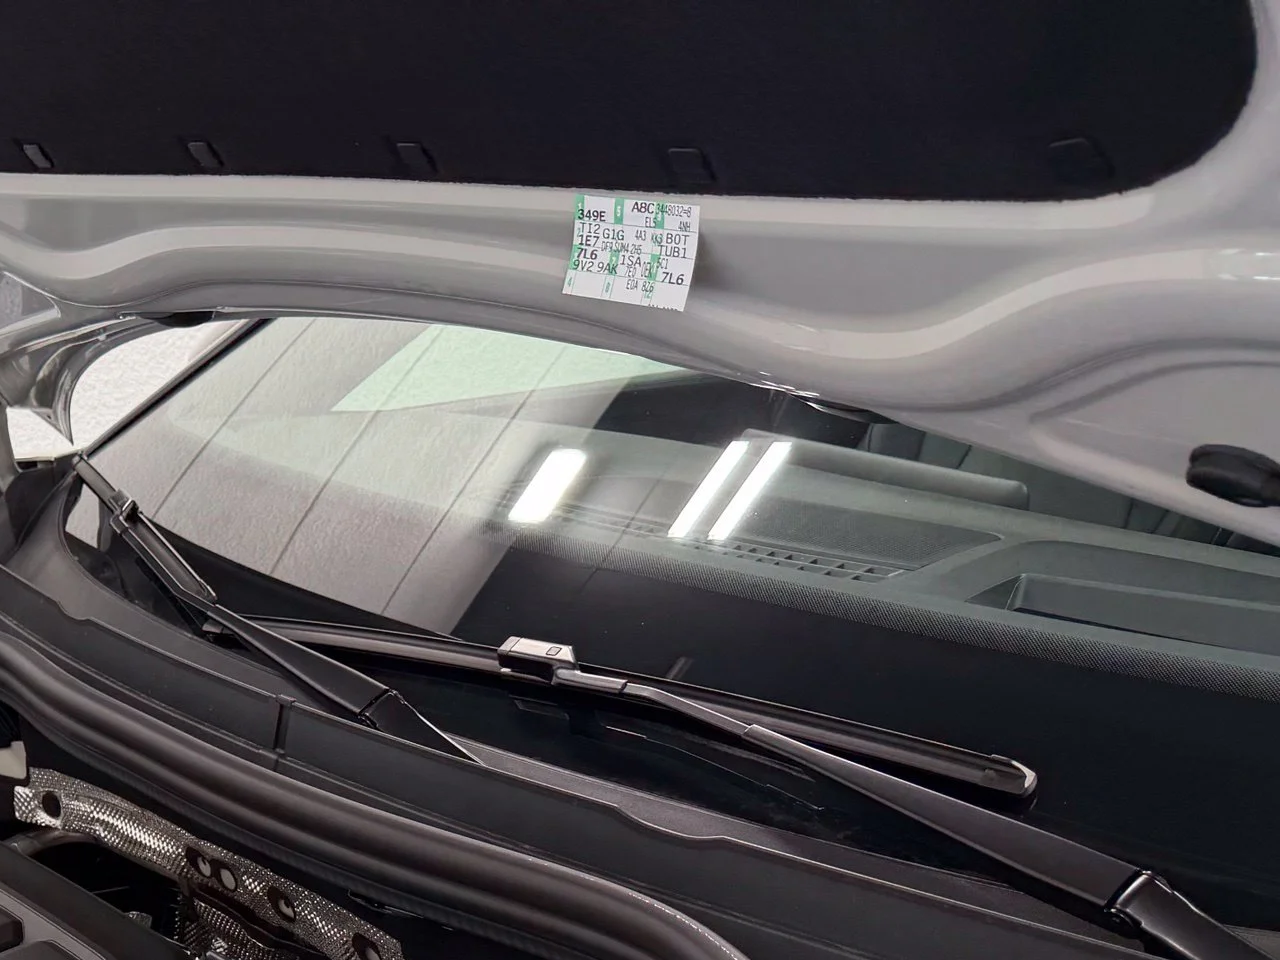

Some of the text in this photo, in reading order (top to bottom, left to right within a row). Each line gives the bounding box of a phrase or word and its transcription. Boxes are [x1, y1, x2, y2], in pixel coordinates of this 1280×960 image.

[631, 201, 655, 214] A8C
[577, 208, 606, 222] 349E
[578, 234, 600, 247] 1E7
[602, 228, 625, 241] G1G
[576, 247, 598, 260] 7L6
[658, 244, 687, 259] TUB1
[572, 259, 619, 275] 9V2 9AK
[619, 254, 642, 268] 1SA
[661, 271, 685, 286] 7L6
